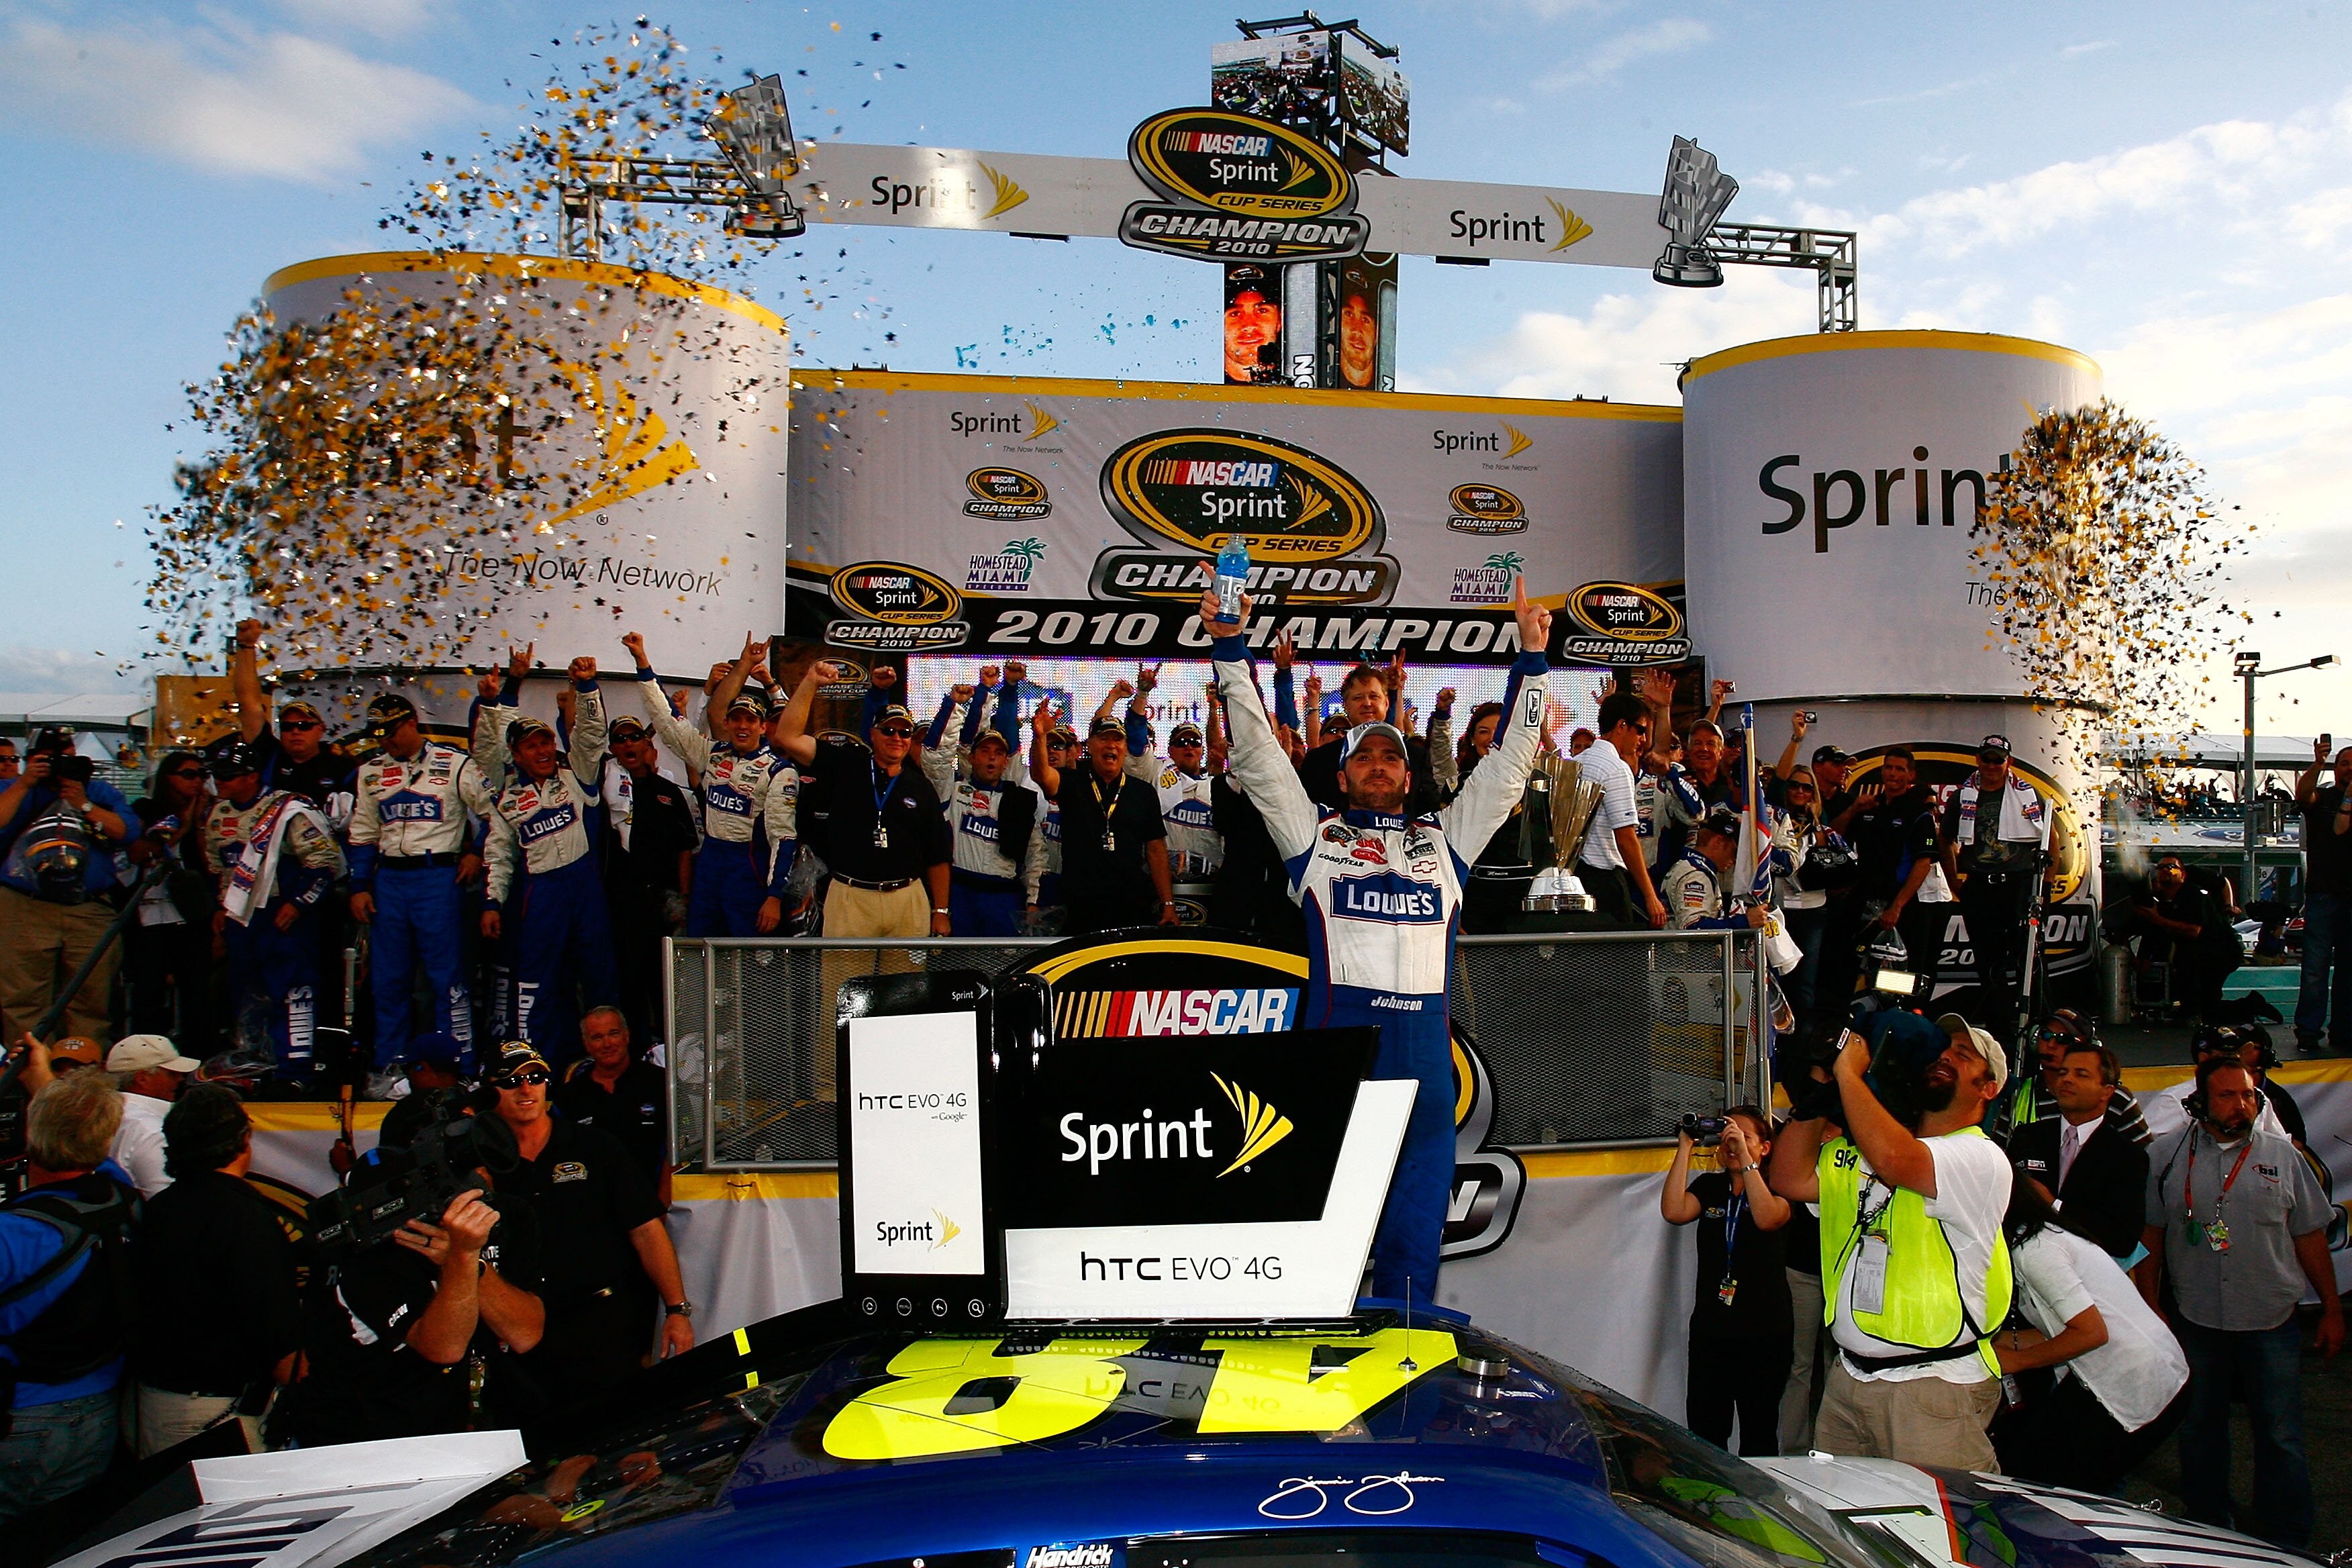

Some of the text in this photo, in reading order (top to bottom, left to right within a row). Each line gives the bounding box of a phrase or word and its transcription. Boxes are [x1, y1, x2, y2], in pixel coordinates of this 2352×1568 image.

[1196, 132, 1268, 156] NASCAR
[1209, 158, 1279, 185] Sprint
[872, 175, 976, 214] Sprint
[1216, 195, 1325, 212] CUP SERIES
[1140, 214, 1351, 244] CHAMPION
[1449, 209, 1546, 246] Sprint
[1216, 241, 1271, 254] 2010
[950, 411, 1022, 438] Sprint
[1034, 446, 1064, 454] Network
[1433, 430, 1499, 454] Sprint
[990, 475, 1016, 484] NASCAR
[1185, 461, 1273, 487] NASCAR
[994, 484, 1020, 494] Sprint
[1471, 492, 1496, 500] NASCAR
[969, 503, 1045, 515] CHAMPION
[1201, 492, 1287, 524] Sprint
[1475, 501, 1499, 510] Sprint
[1453, 518, 1524, 530] CHAMPION
[1211, 537, 1344, 552] CP SERIES
[969, 555, 1027, 571] HOMESTEAD
[444, 550, 724, 596] The Now Network
[967, 569, 1024, 583] MIAMI
[1454, 568, 1507, 583] HOMESTEAD
[868, 577, 911, 589] NASCAR
[1451, 583, 1504, 595] MIAMI
[875, 591, 918, 607] Sprint
[1600, 595, 1640, 607] NASCAR
[1965, 582, 2008, 605] The
[880, 611, 944, 621] CUP SERIES
[1608, 608, 1645, 624] Sprint
[834, 625, 960, 640] CHAMPION
[987, 610, 1160, 647] 2010
[1612, 629, 1669, 638] CUP SERIES
[879, 639, 913, 648] 2010
[1571, 641, 1683, 656] CHAMPION
[1611, 654, 1641, 663] 2010
[1160, 771, 1178, 789] 48
[707, 789, 744, 812] LOWE'S
[524, 809, 573, 838] LOWE'S
[966, 816, 999, 840] LOWE
[1318, 852, 1365, 868] GOODYEAR
[1346, 884, 1435, 916] LOWE'S
[1765, 920, 1780, 938] 48
[951, 990, 974, 1001] Sprint
[1371, 995, 1423, 1011] Johnson
[1126, 989, 1289, 1037] NASCAR
[285, 985, 314, 1059] LOWE'S
[946, 1092, 967, 1107] 4G
[939, 1112, 965, 1123] Google
[1060, 1108, 1214, 1175] Sprint
[2258, 1164, 2278, 1177] bsi
[877, 1220, 933, 1246] Sprint
[1244, 1256, 1283, 1280] 4G
[1025, 1543, 1114, 1568] Hendrick
